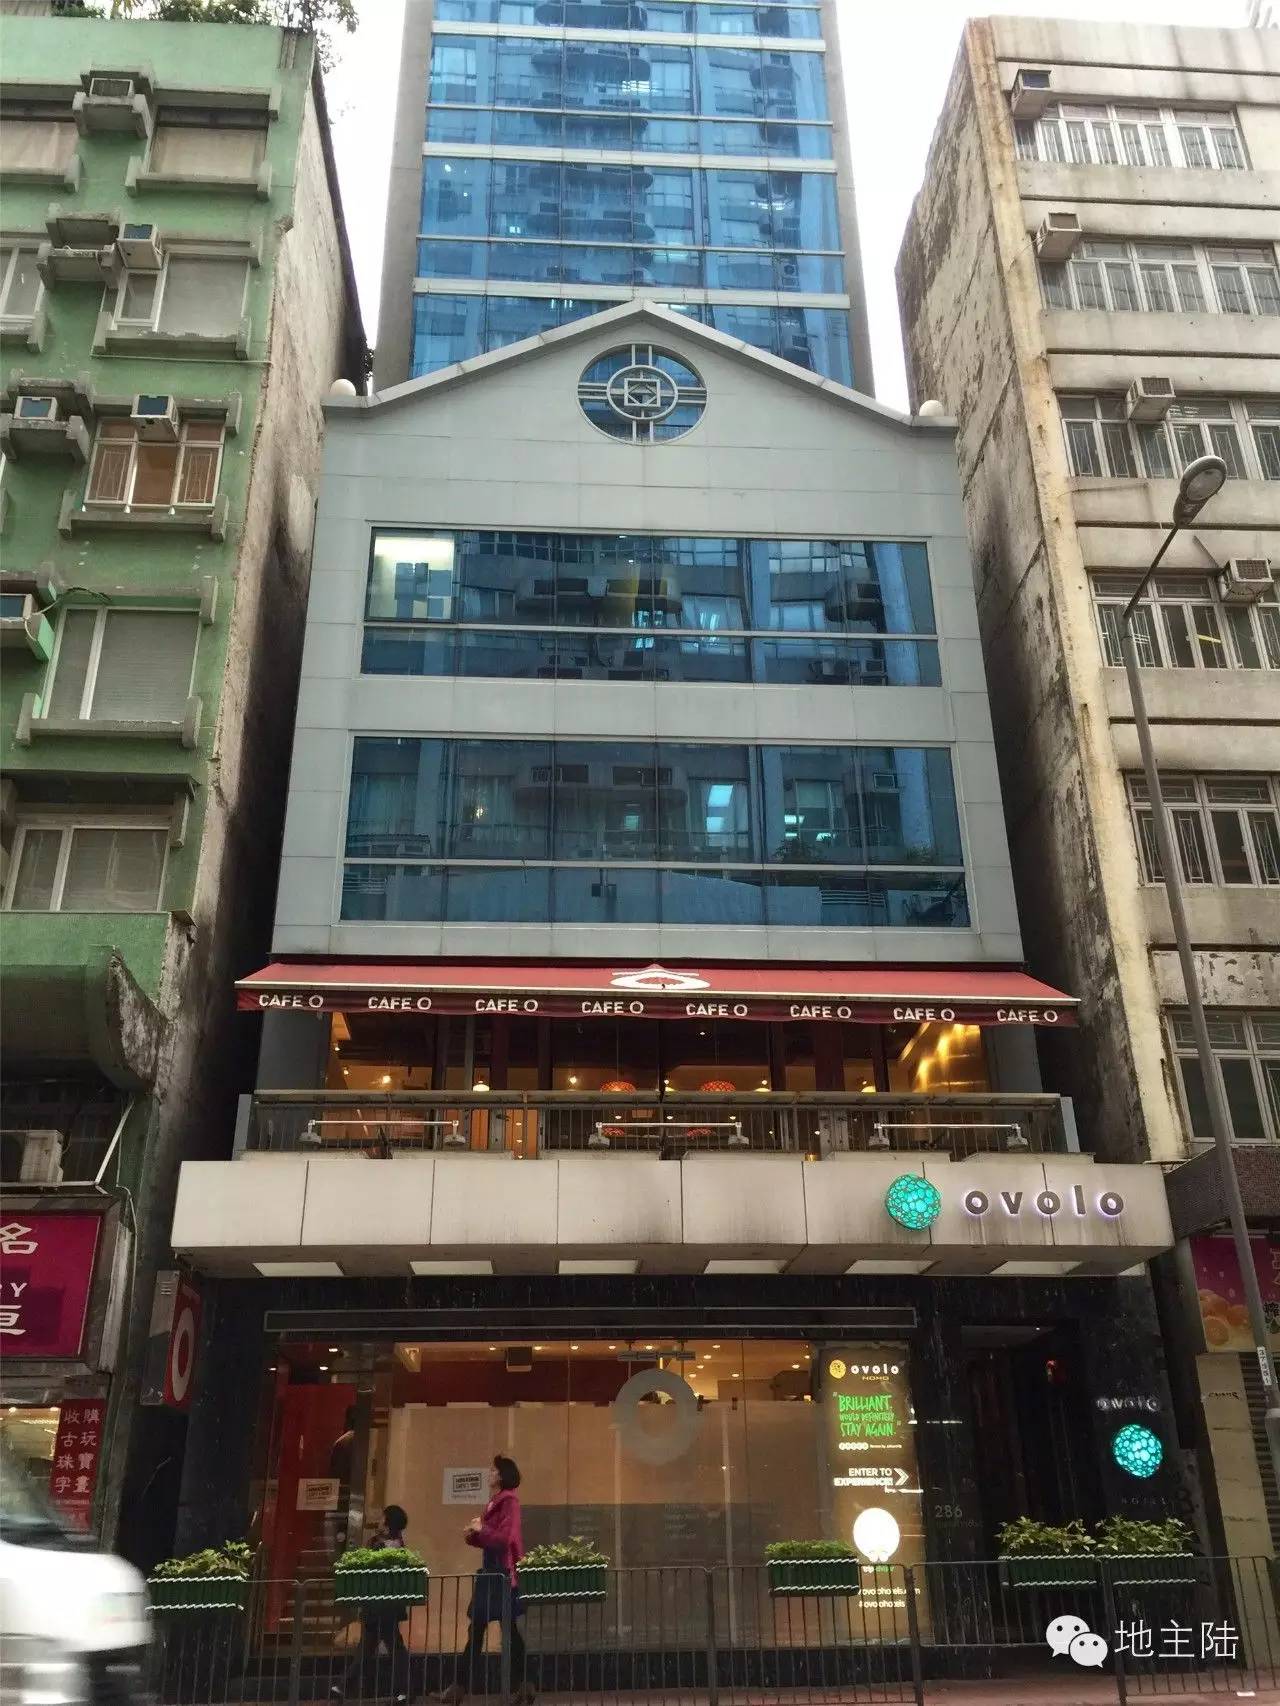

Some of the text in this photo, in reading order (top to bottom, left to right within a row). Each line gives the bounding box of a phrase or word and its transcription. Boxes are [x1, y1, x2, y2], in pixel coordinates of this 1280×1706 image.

[258, 994, 324, 1009] CAFE O
[367, 996, 432, 1011] CAFE O
[475, 998, 539, 1014] CAFE O
[581, 1000, 645, 1015] CAFE O
[685, 1002, 748, 1018] CAFE O
[789, 1004, 852, 1020] CAFE O
[893, 1007, 956, 1022] CAFE O
[996, 1008, 1059, 1023] CAFE O
[964, 1184, 1125, 1216] ovolo
[850, 1363, 899, 1375] ovolo
[840, 1422, 861, 1437] STAY
[848, 1467, 893, 1477] ENTER TO
[934, 1504, 963, 1518] 286
